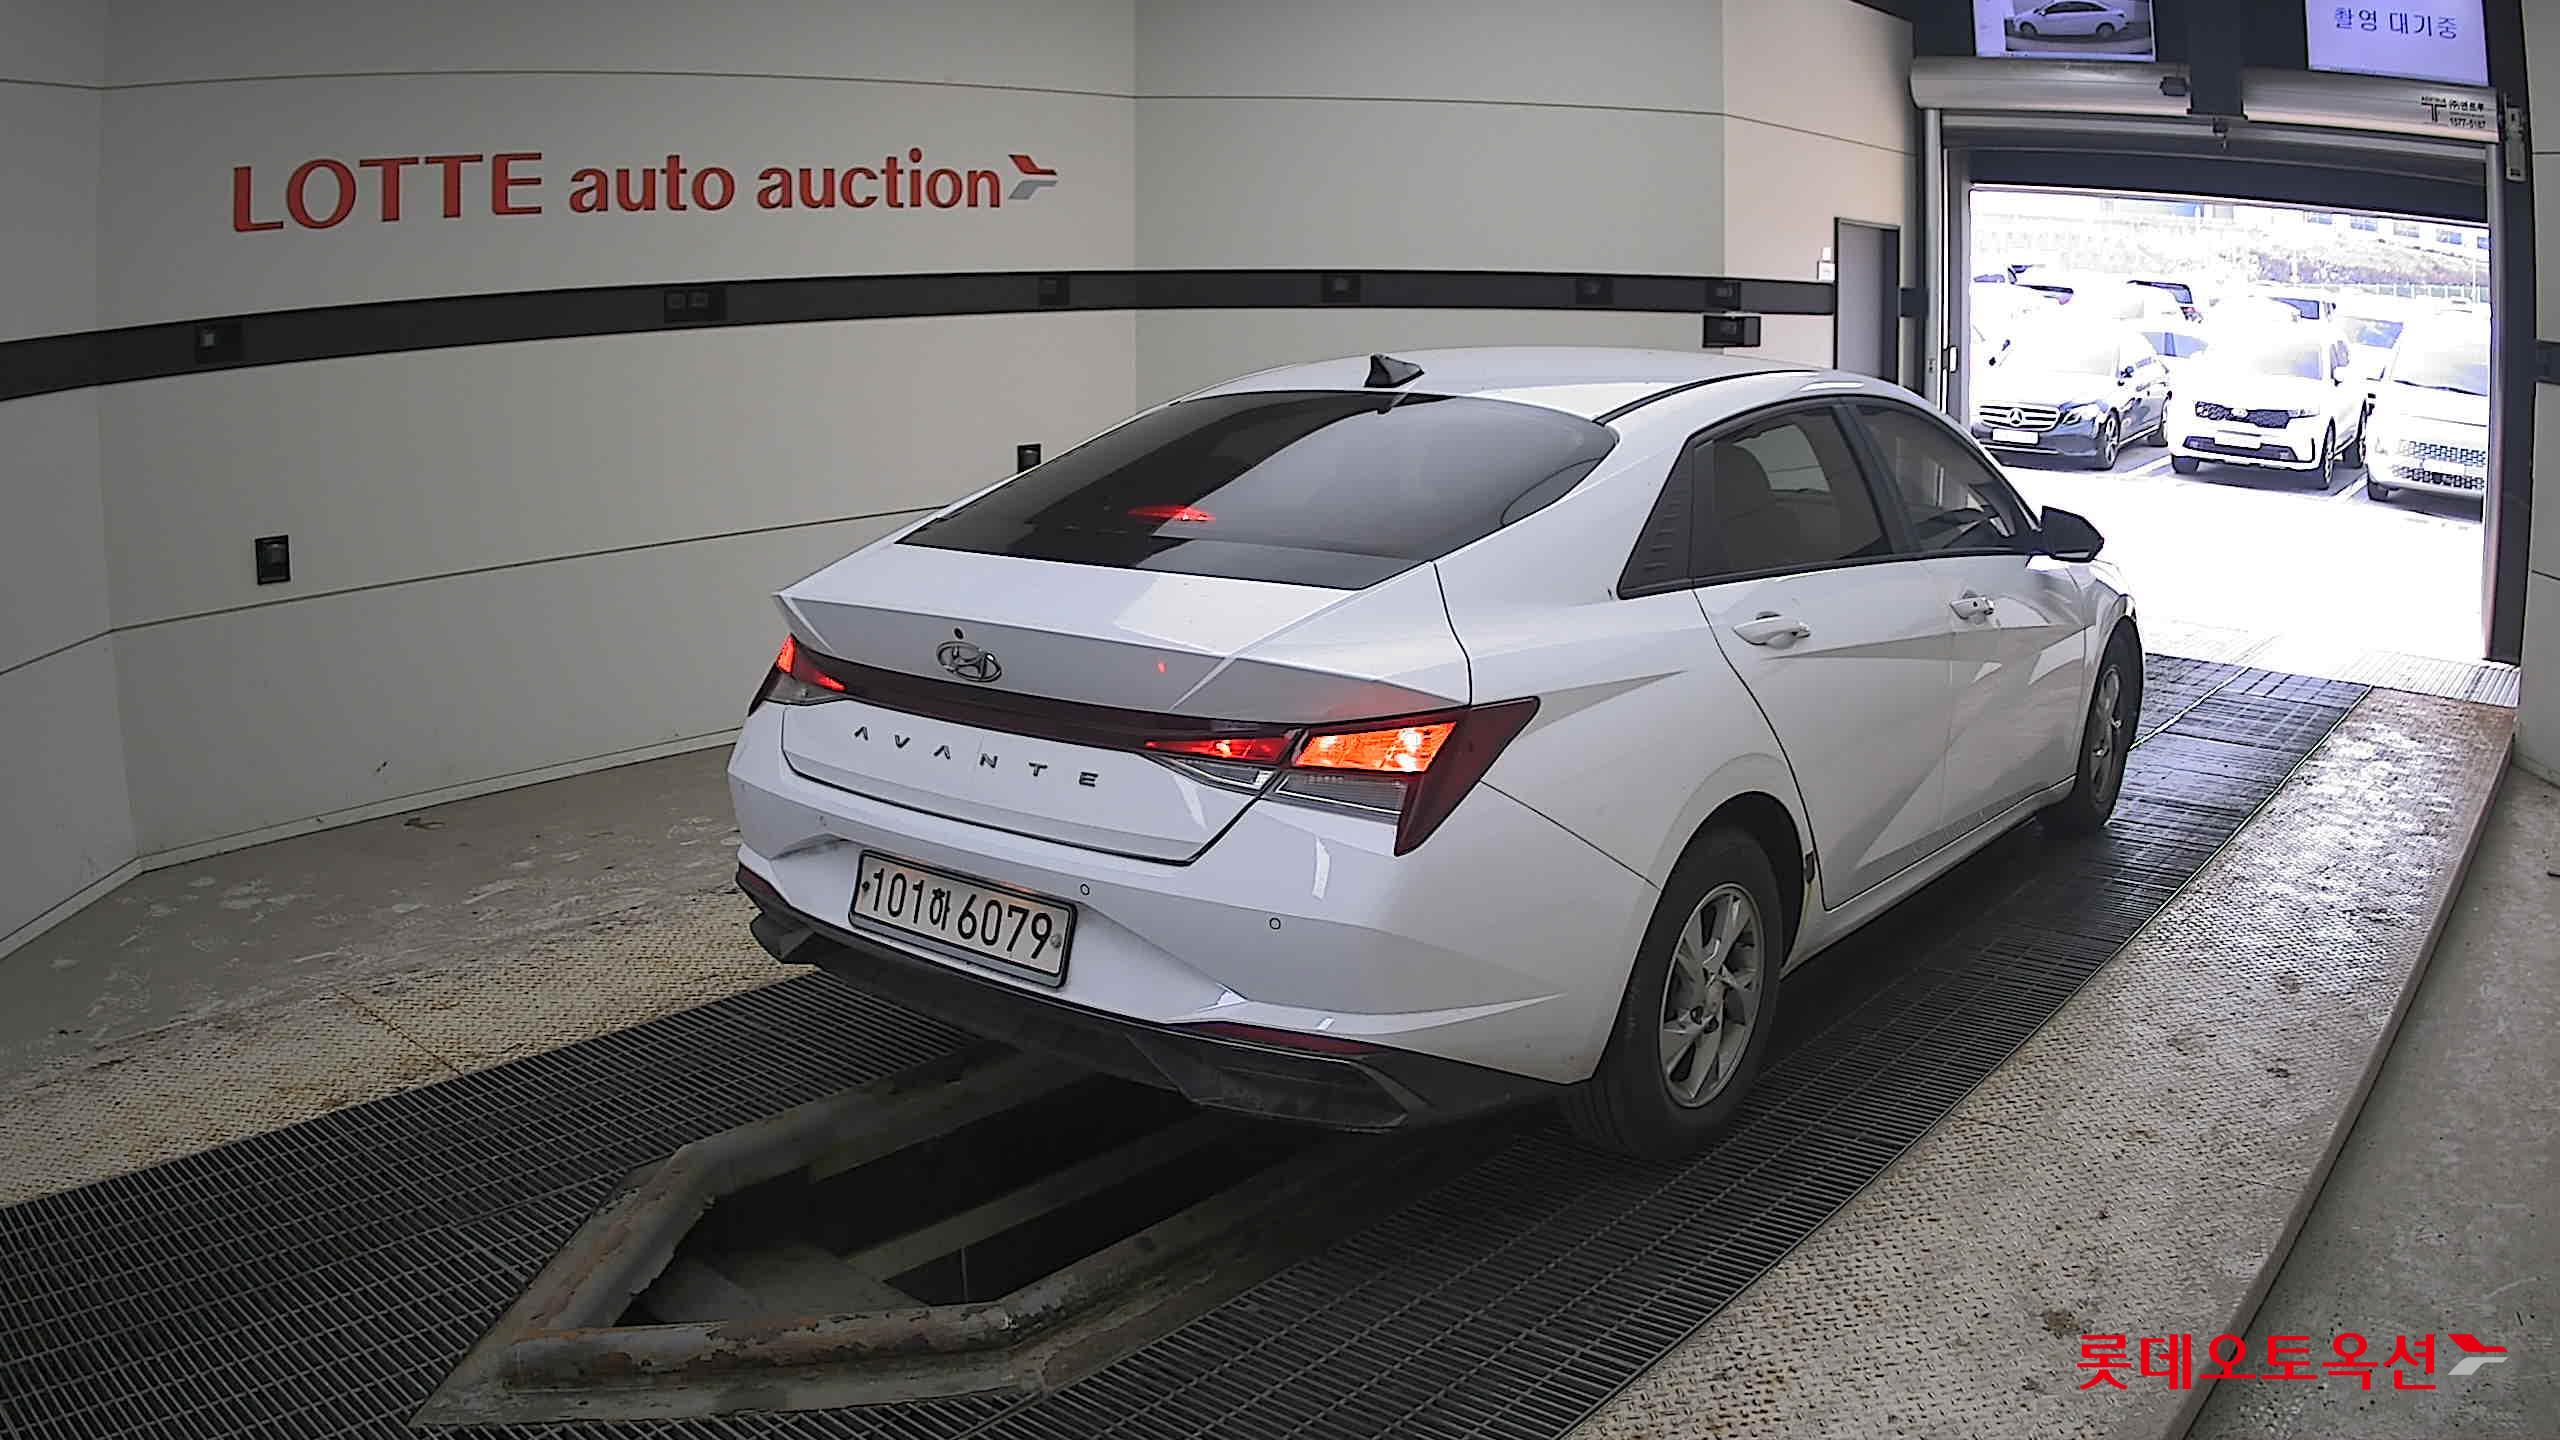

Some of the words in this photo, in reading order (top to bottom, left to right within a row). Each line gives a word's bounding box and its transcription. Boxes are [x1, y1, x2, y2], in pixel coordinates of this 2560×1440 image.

[2335, 7, 2378, 32] 촬영
[2389, 12, 2457, 40] 대기중
[233, 152, 542, 233] LOTTE
[570, 155, 737, 213] auto
[758, 148, 1003, 210] auction
[853, 726, 1099, 788] AVANTE
[872, 867, 1053, 960] 101하6079
